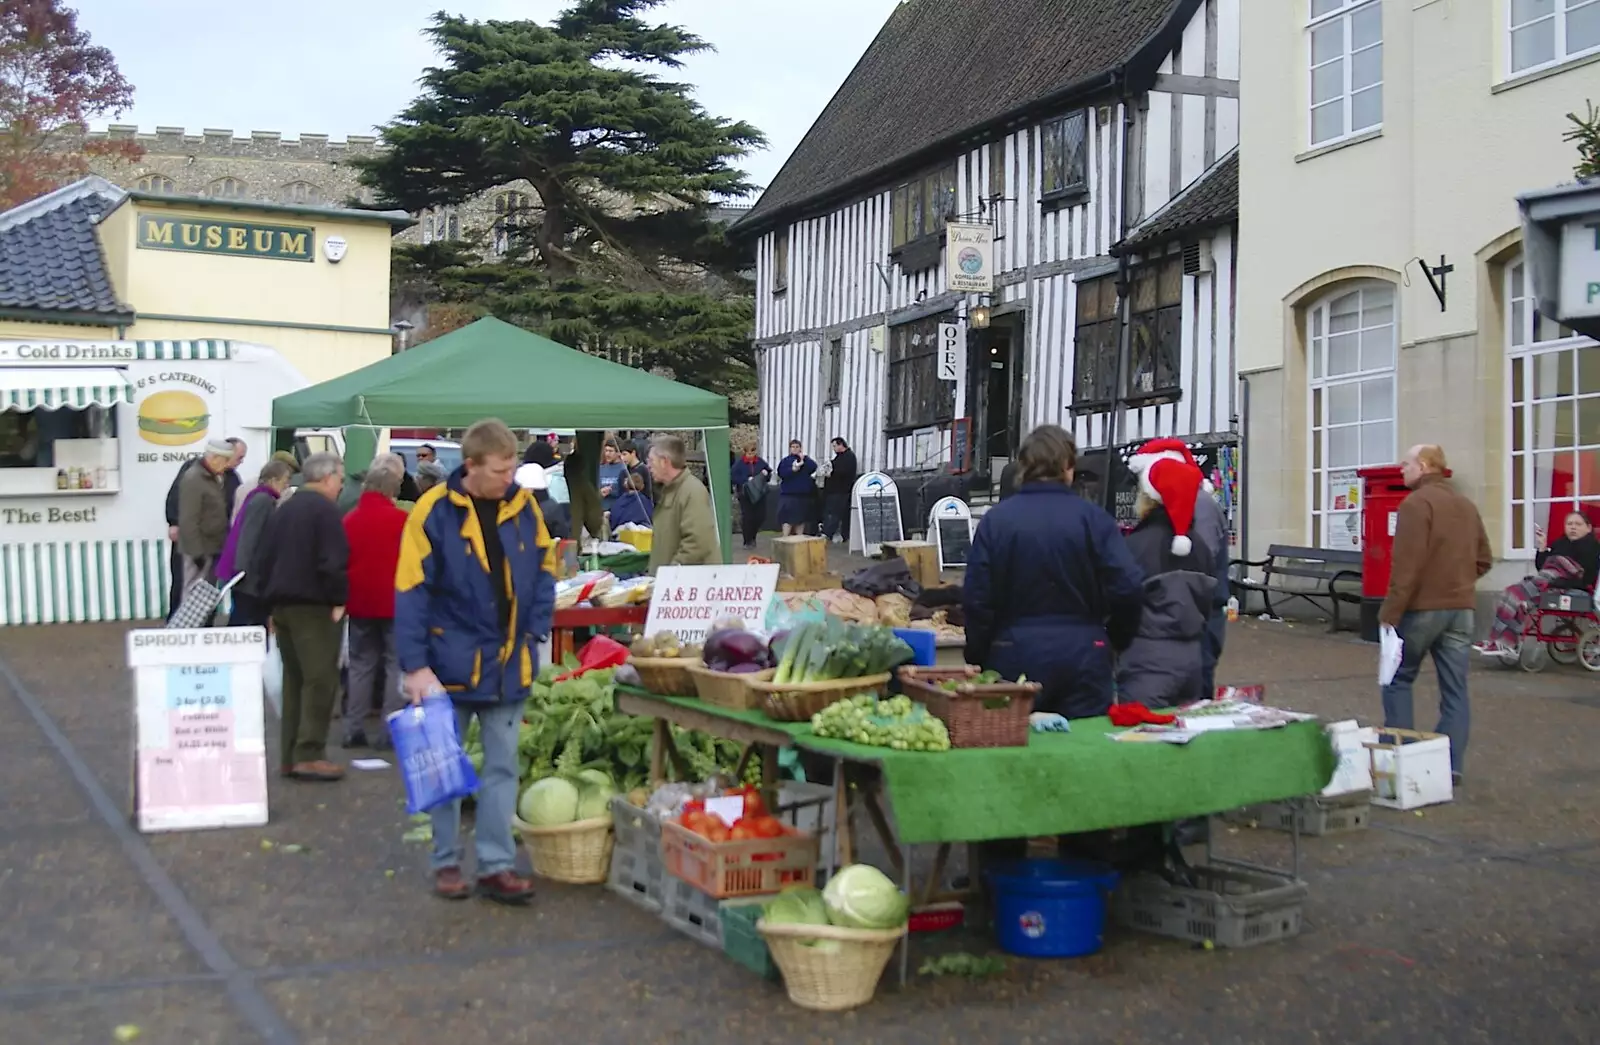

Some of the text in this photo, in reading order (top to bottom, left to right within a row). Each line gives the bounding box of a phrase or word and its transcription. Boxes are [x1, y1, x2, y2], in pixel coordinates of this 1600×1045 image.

[146, 220, 307, 255] MUSEUM
[17, 345, 60, 359] Cold
[65, 345, 133, 359] Drinks
[944, 326, 957, 377] OPEN
[148, 375, 157, 385] S
[159, 372, 218, 395] CATERING
[138, 451, 205, 462] BIG SNACK
[3, 506, 97, 524] The Best!
[661, 586, 763, 601] A & B GARNER
[656, 606, 712, 619] PRODUCE
[134, 632, 263, 647] SPROUT STALKS
